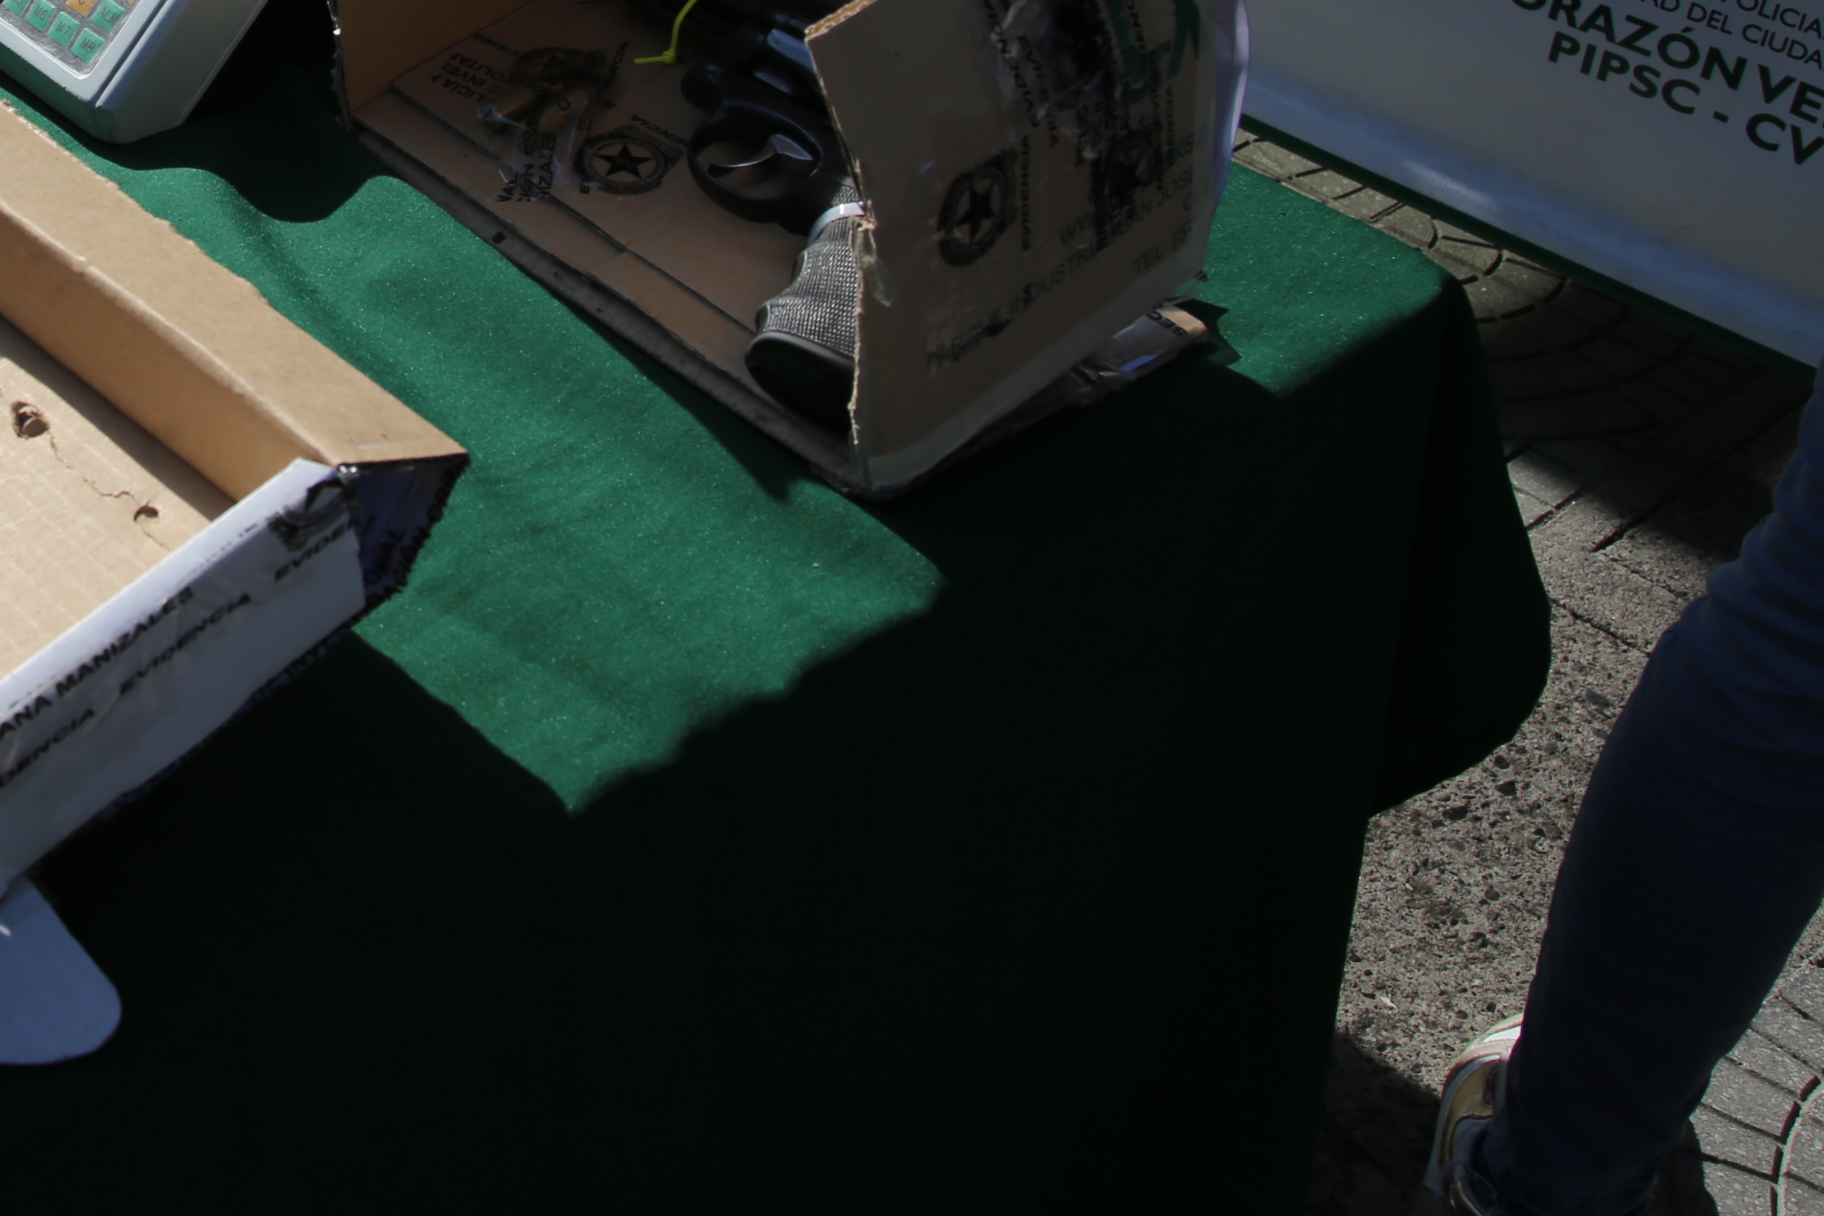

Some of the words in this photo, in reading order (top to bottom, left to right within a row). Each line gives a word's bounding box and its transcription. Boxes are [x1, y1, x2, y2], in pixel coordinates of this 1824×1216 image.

[1686, 1, 1733, 36] DEL
[1741, 23, 1824, 72] CIUDA
[1547, 30, 1701, 116] PIPSC
[1745, 112, 1824, 166] CV
[1757, 63, 1824, 130] VE
[55, 585, 194, 698] MANIZALES
[119, 592, 251, 696] EVIDENCIA
